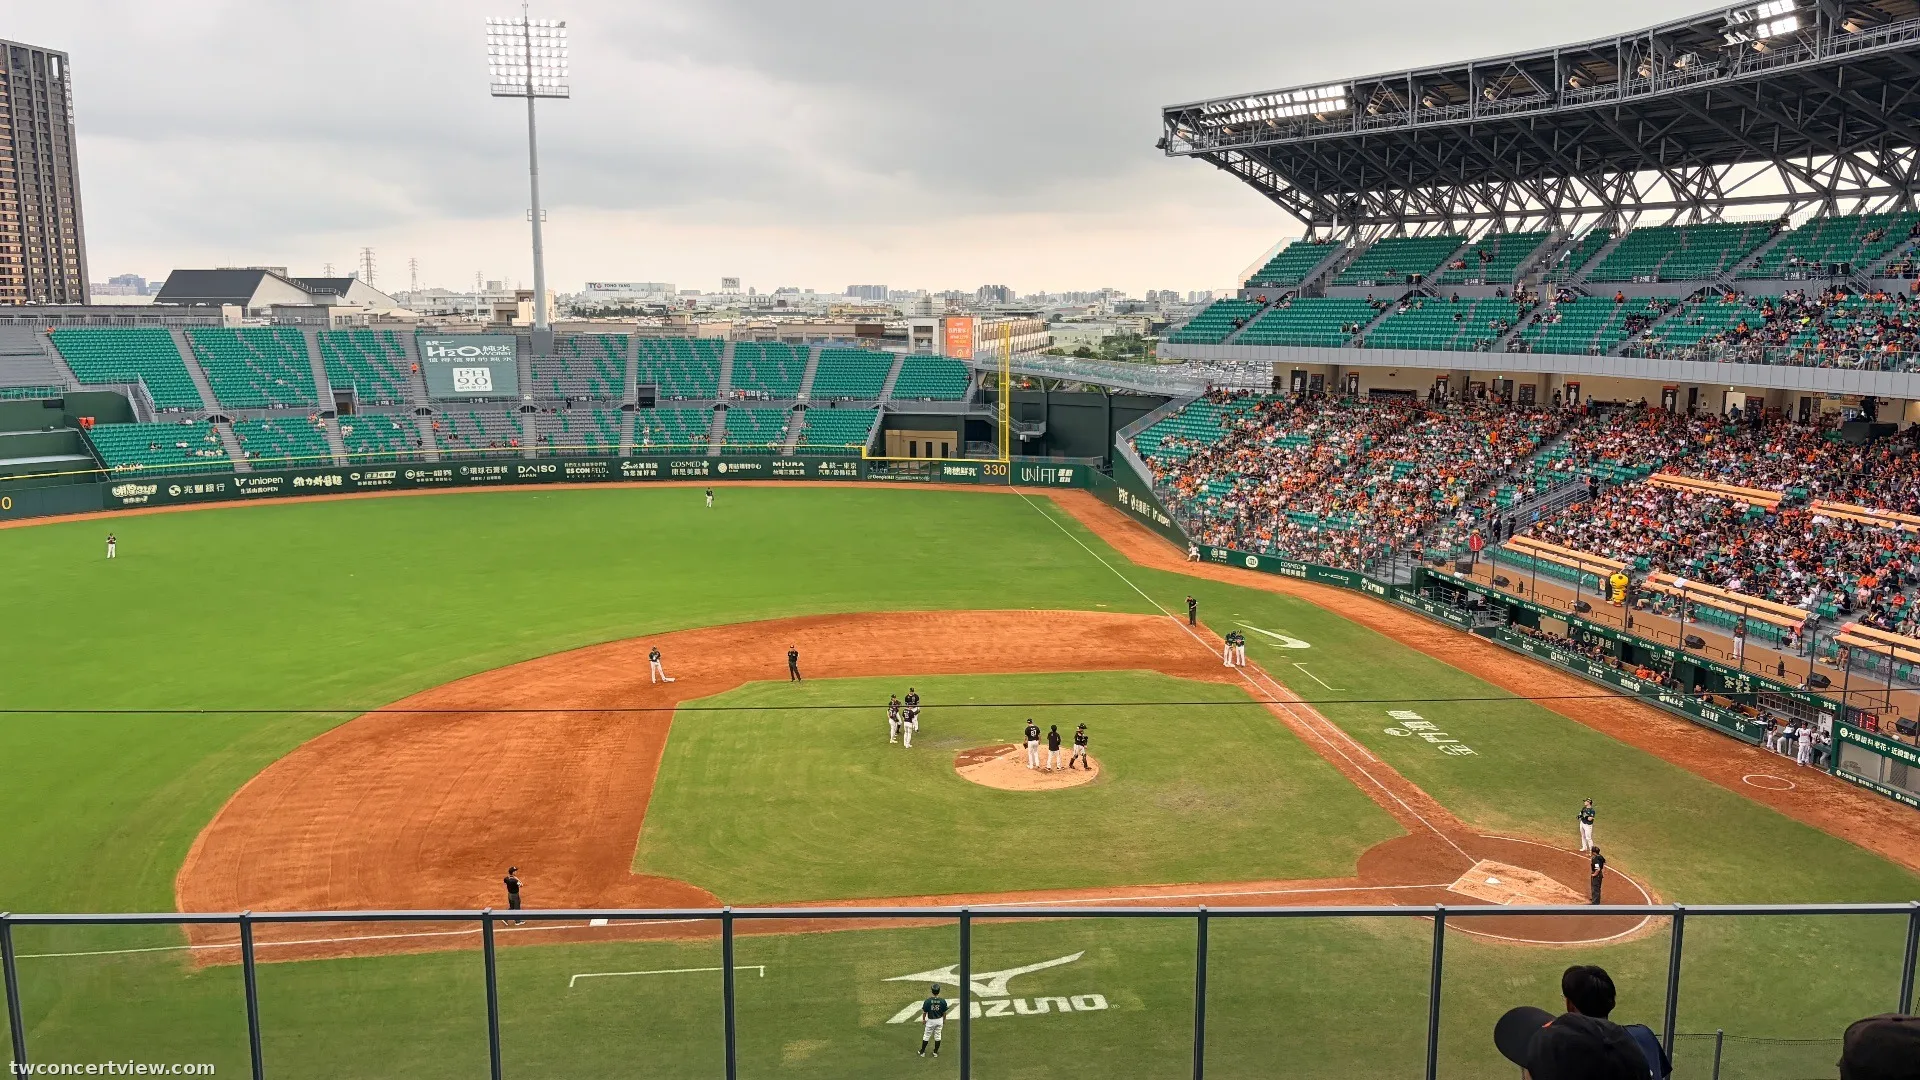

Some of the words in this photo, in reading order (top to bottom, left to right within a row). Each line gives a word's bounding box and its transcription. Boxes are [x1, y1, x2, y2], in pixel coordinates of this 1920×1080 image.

[457, 377, 489, 386] 9.0
[470, 466, 508, 475] 環球石膏板
[517, 464, 557, 473] DAISO
[943, 465, 977, 477] 瑞穗鮮乳
[983, 463, 1007, 476] 330
[248, 476, 284, 486] uniopen
[183, 483, 226, 495] 兆豐銀行
[1, 496, 12, 510] 0
[1280, 561, 1301, 570] COSMED
